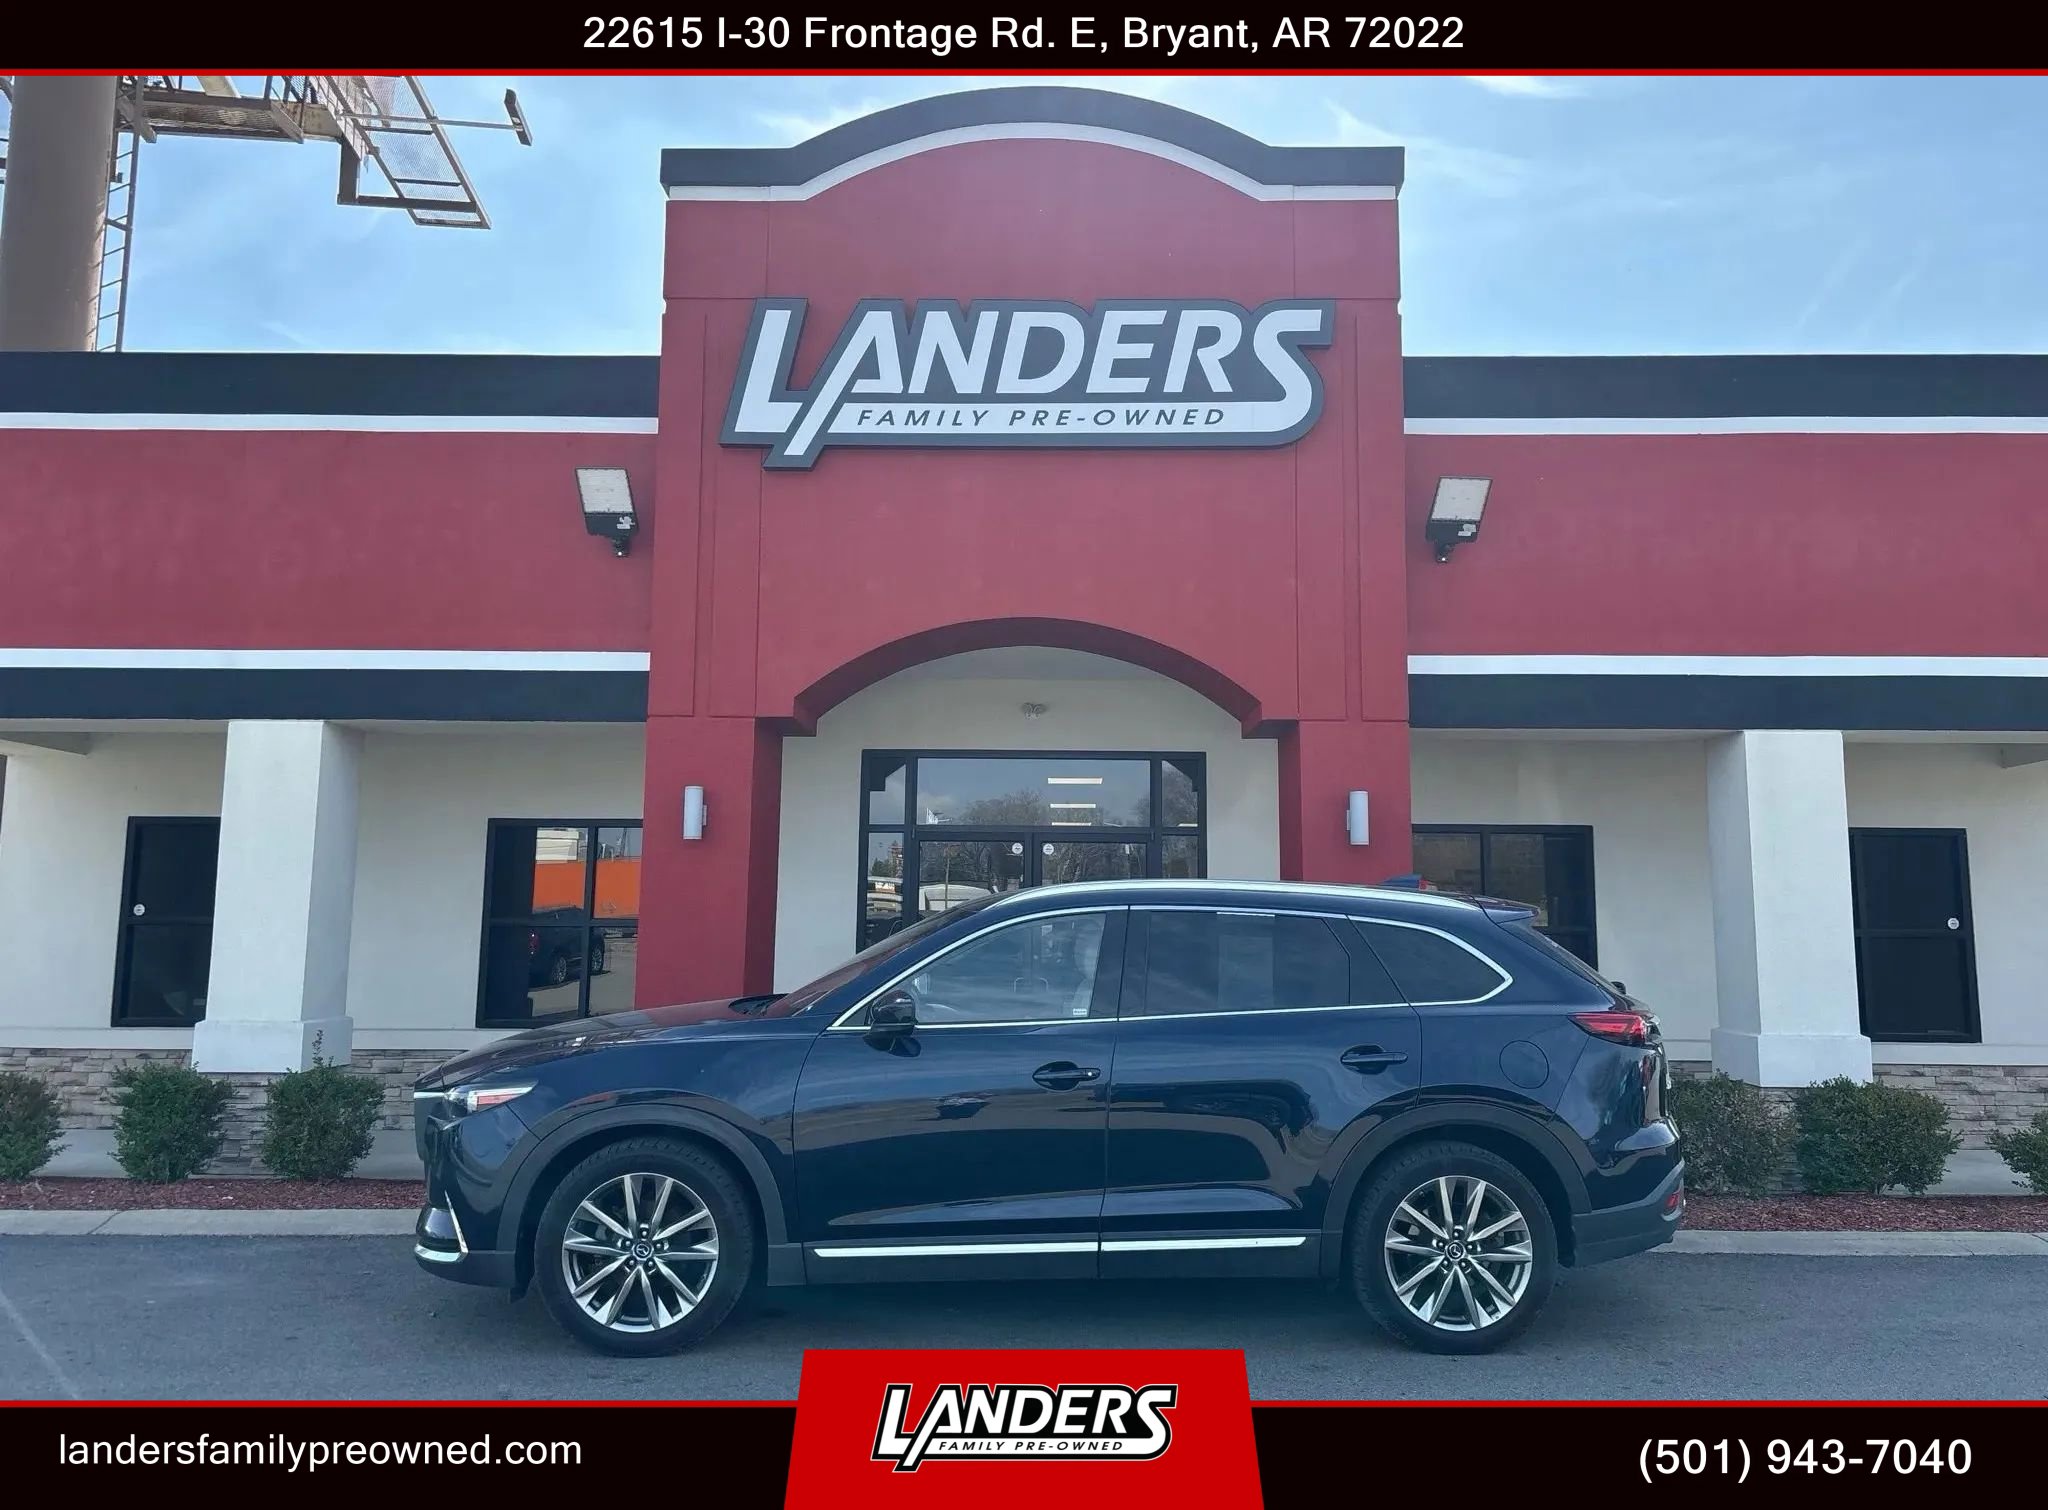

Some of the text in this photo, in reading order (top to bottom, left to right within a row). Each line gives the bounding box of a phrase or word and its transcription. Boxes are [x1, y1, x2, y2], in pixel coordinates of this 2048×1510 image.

[734, 309, 1322, 456] LANDERS
[857, 408, 1224, 426] FAMILY PRE-OWNED
